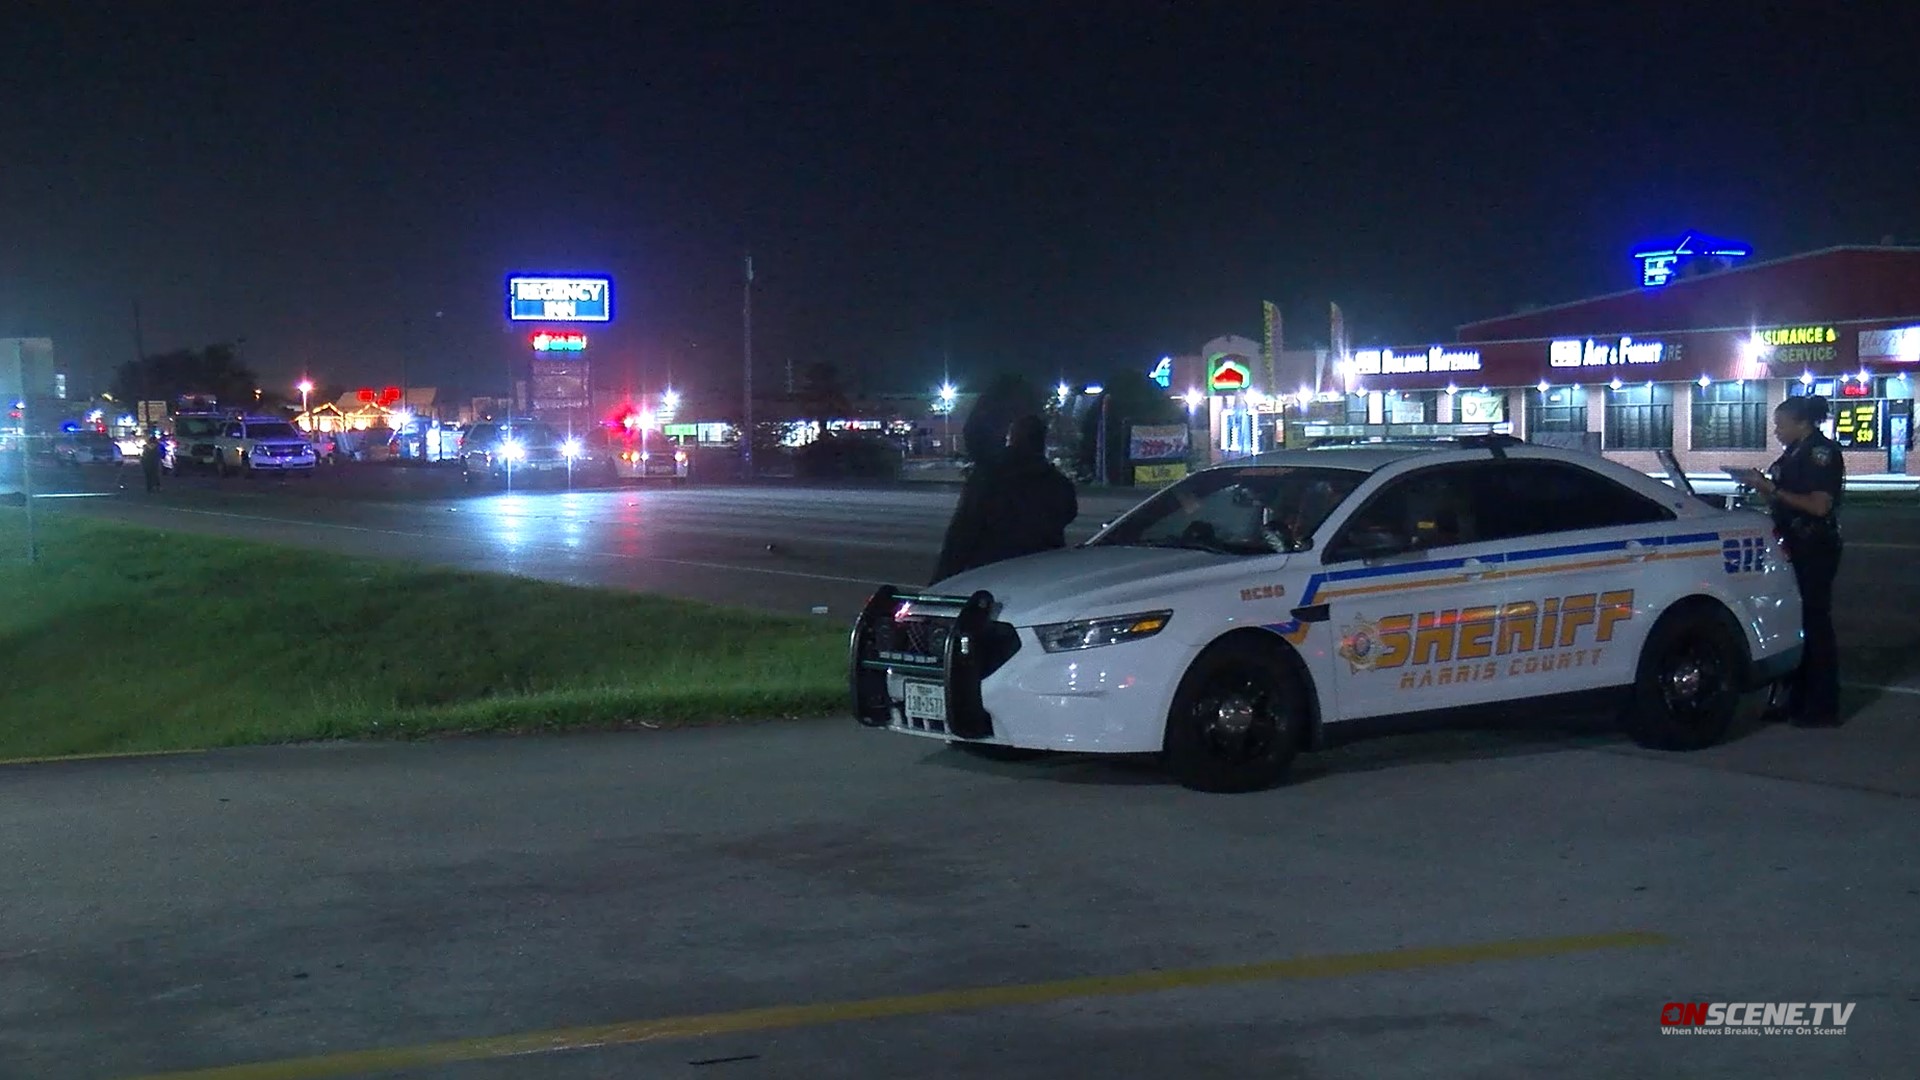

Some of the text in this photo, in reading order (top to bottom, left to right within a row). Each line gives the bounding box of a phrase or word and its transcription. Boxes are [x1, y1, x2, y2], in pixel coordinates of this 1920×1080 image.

[517, 283, 602, 301] REGENCY
[543, 301, 576, 317] INN
[1752, 327, 1823, 345] NSURANCE
[1780, 347, 1834, 362] SERVICE
[1373, 589, 1635, 669] SHERIFF
[1400, 649, 1602, 689] HARRIS COUNTY
